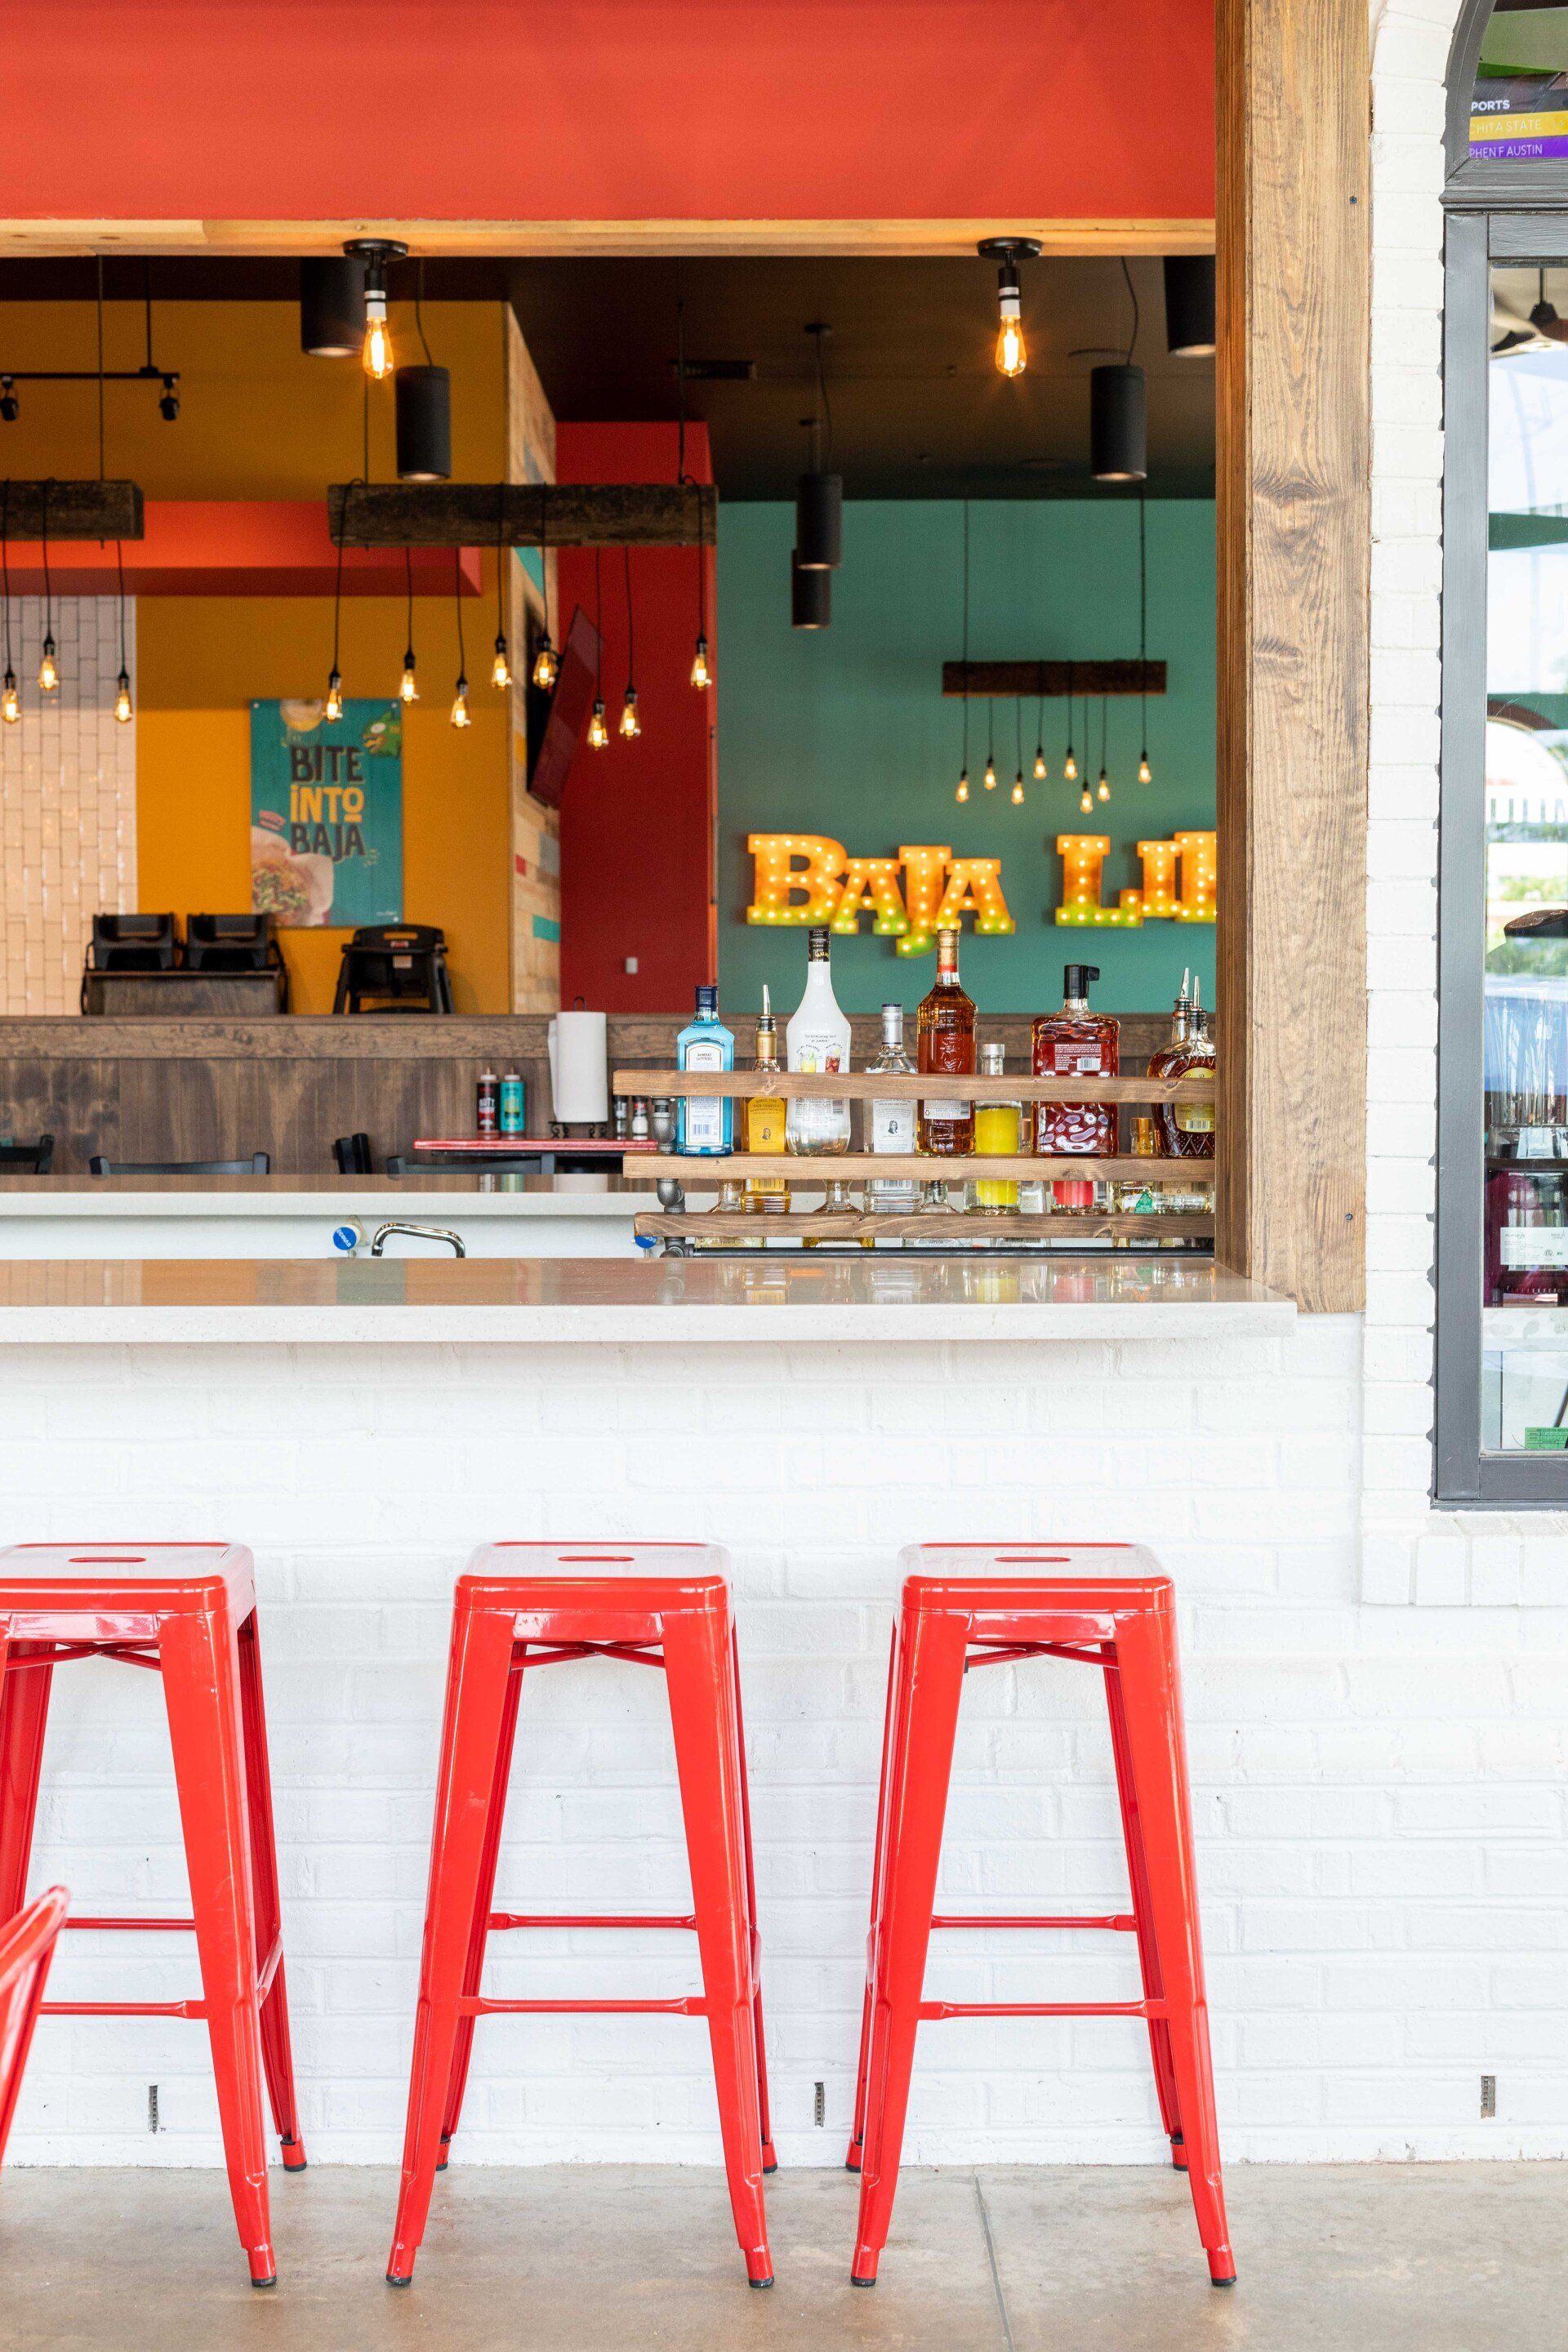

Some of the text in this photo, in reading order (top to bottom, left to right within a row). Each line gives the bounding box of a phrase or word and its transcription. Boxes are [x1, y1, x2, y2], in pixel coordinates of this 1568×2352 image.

[1507, 119, 1542, 131] STATE
[1499, 146, 1504, 157] F
[1507, 144, 1543, 157] AUSTIN
[290, 746, 364, 784] BITE
[290, 822, 366, 863] BAJA
[746, 834, 1016, 958] BAJA
